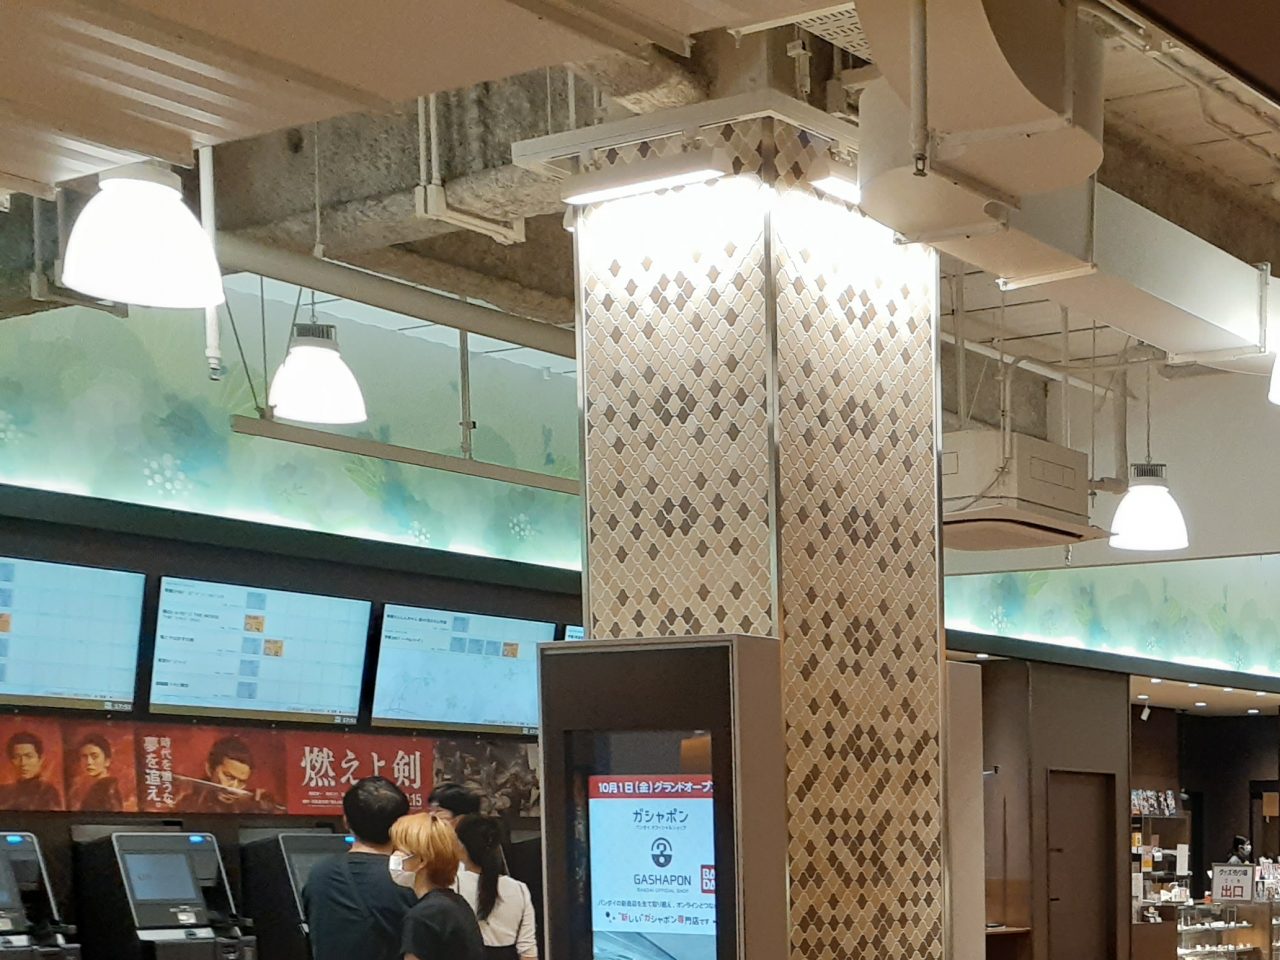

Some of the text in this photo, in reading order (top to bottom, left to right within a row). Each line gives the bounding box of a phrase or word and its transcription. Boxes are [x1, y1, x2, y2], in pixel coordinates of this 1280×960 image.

[300, 746, 421, 789] 燃えよ剣
[405, 793, 422, 806] .15
[633, 808, 689, 823] ガシャポン
[703, 868, 715, 878] BA
[634, 874, 692, 886] GASHAPON
[704, 879, 716, 890] DA
[1221, 885, 1244, 898] 出口
